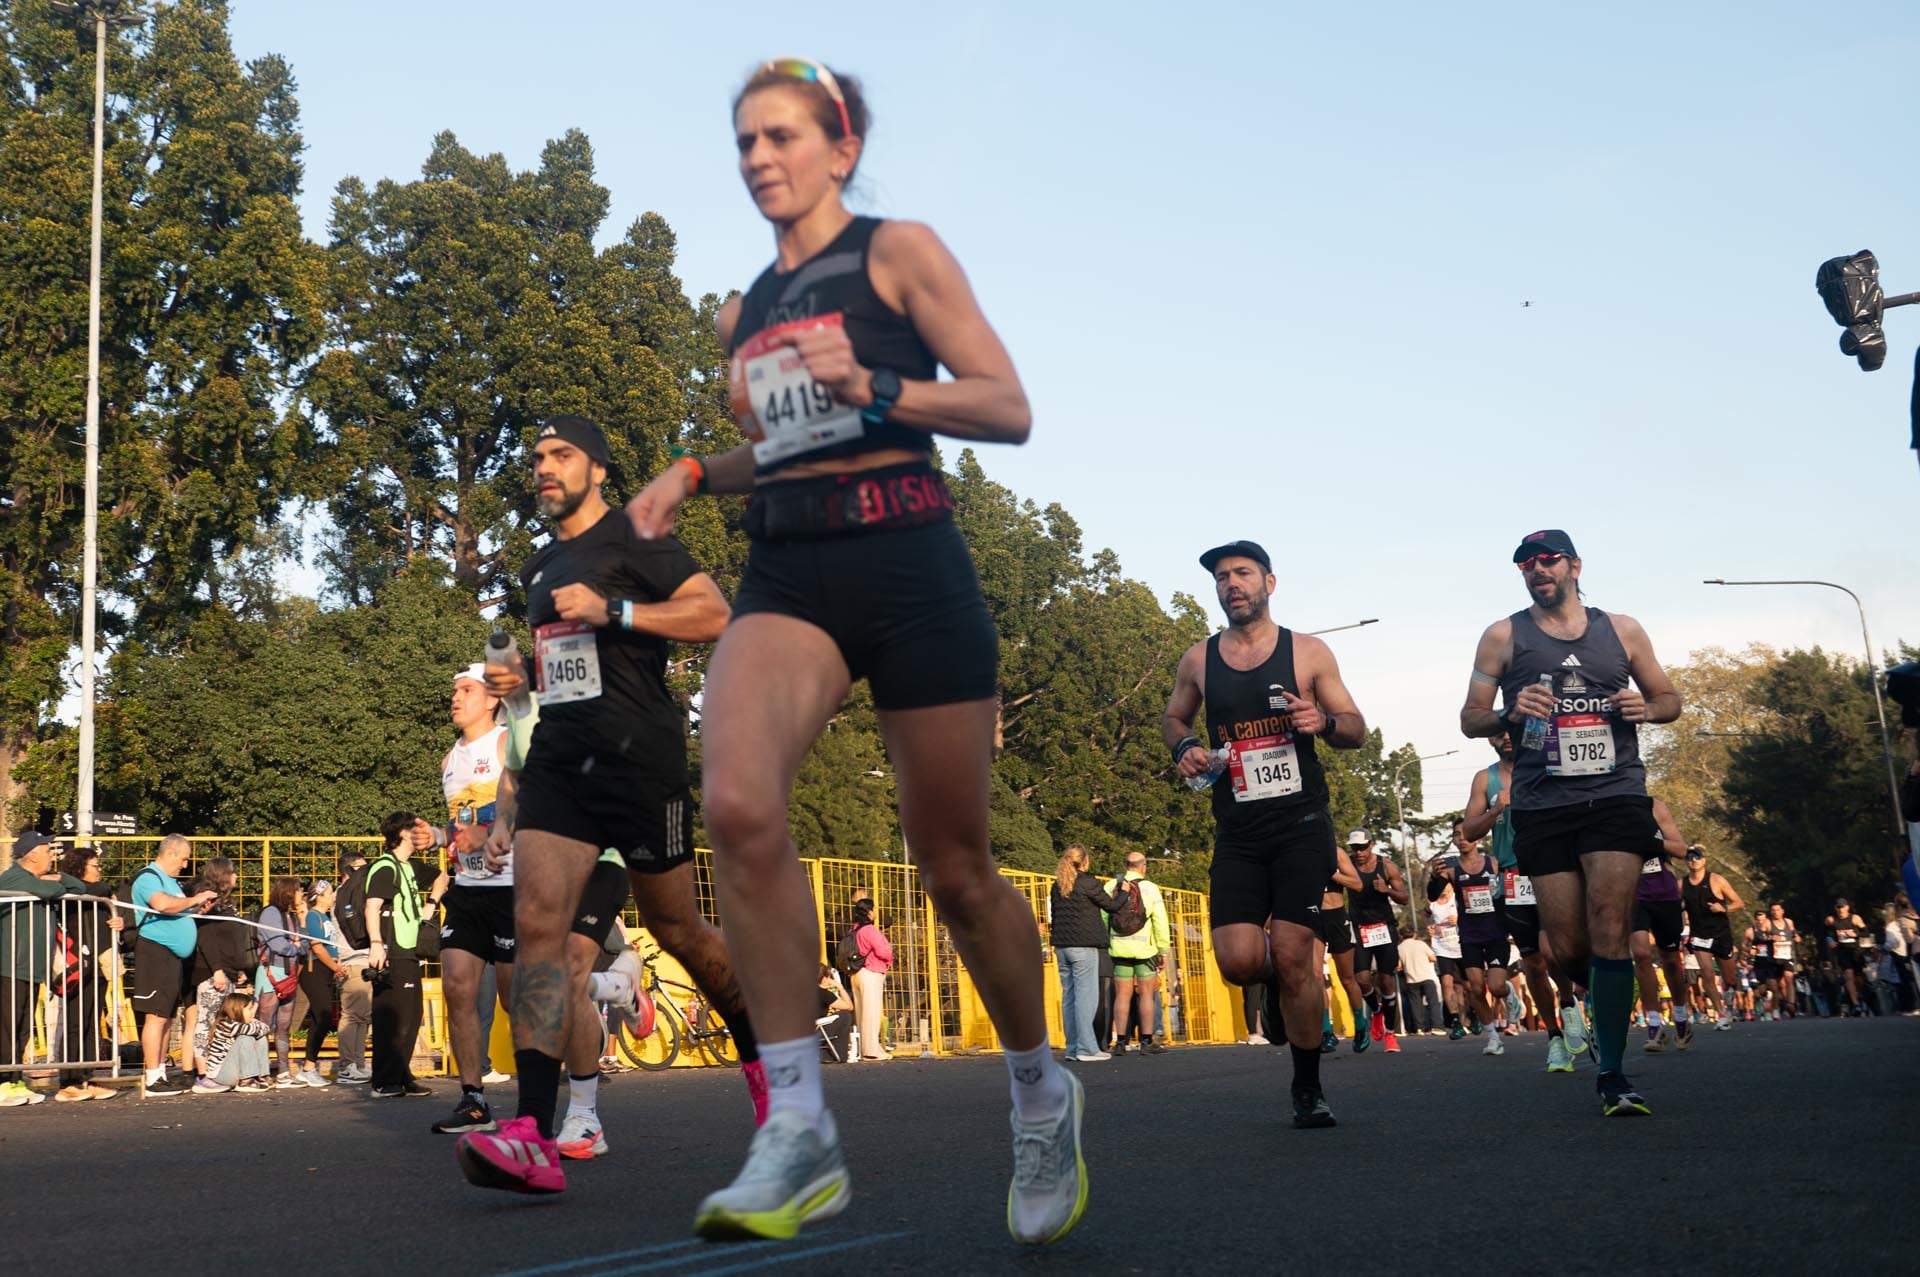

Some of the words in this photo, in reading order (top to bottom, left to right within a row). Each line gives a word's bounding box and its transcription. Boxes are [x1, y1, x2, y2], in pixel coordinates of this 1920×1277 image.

[765, 381, 832, 428] 4419
[547, 657, 587, 685] 2466
[1575, 729, 1608, 739] SEBASTIAN
[1231, 749, 1237, 760] C
[1262, 750, 1288, 761] JOAQUIN
[1569, 742, 1607, 761] 9782
[1254, 762, 1292, 785] 1345
[465, 856, 485, 871] 165
